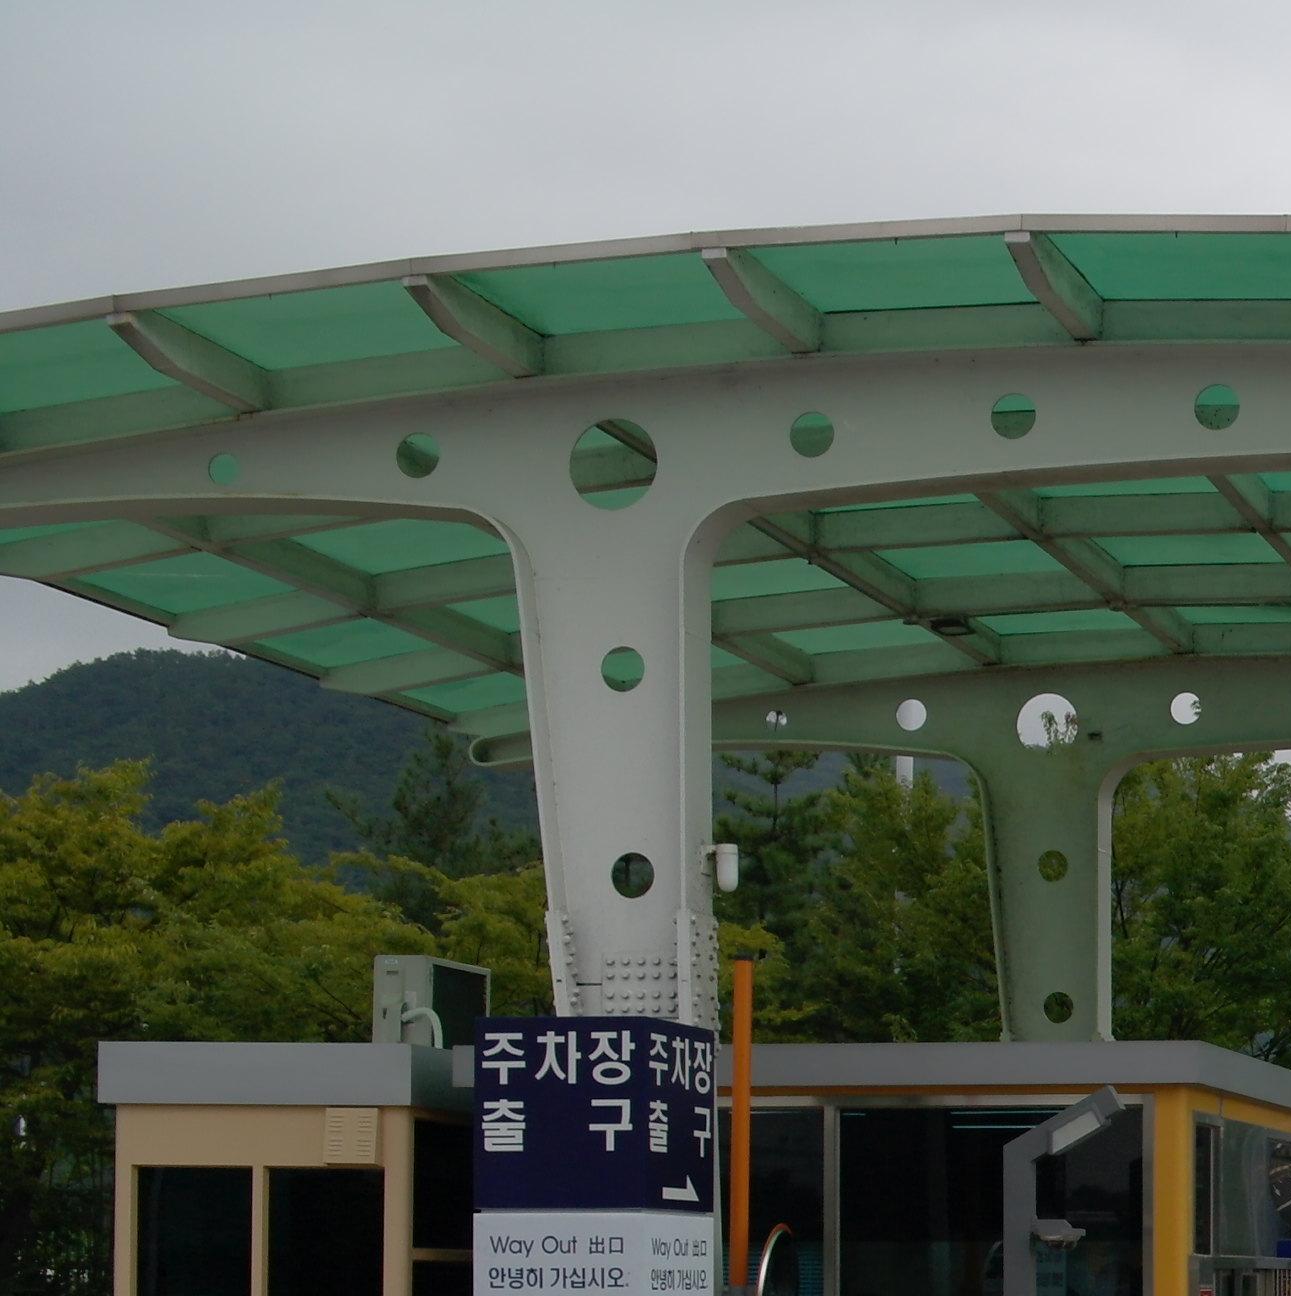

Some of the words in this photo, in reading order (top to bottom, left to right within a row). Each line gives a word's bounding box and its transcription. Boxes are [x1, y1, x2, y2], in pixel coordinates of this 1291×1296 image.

[482, 1030, 636, 1085] 주차장
[649, 1033, 712, 1094] 주차장
[489, 1236, 534, 1258] Way
[541, 1235, 578, 1254] Out
[589, 1236, 624, 1254] 出口
[651, 1238, 671, 1260] Way
[673, 1238, 688, 1256] Out
[488, 1267, 543, 1289] 안녕히
[651, 1269, 675, 1290] 안녕히
